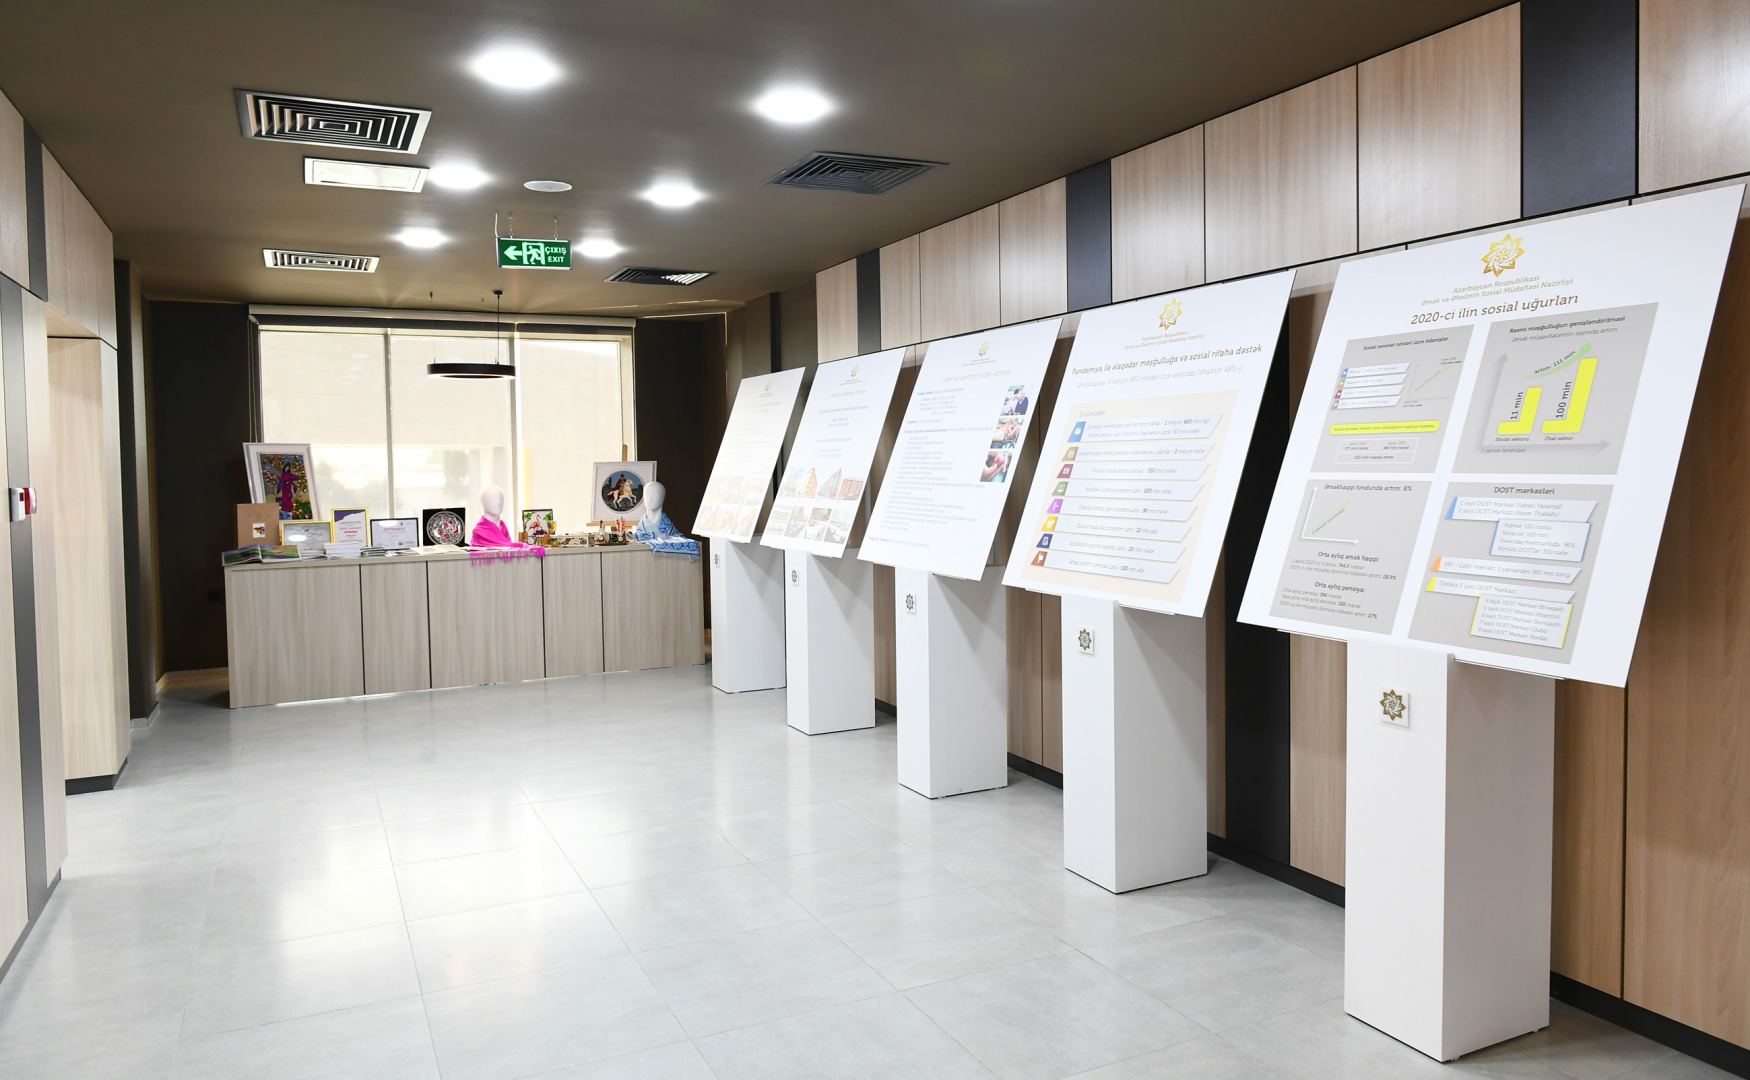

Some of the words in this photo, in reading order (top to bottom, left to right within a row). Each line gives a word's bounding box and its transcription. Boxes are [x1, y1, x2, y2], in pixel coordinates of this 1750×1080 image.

[544, 246, 566, 255] ÇIXIŞ
[1410, 310, 1455, 324] 2020-ci
[1458, 306, 1478, 319] ilin
[1481, 300, 1518, 316] sosial
[1522, 294, 1578, 312] uğurları
[1189, 350, 1211, 360] sosial
[1212, 347, 1234, 357] rifaha
[1235, 344, 1262, 356] dəstək
[1564, 350, 1576, 360] min
[1514, 391, 1524, 409] min
[1556, 402, 1567, 418] 100
[1562, 381, 1572, 399] min
[1510, 410, 1519, 420] 11
